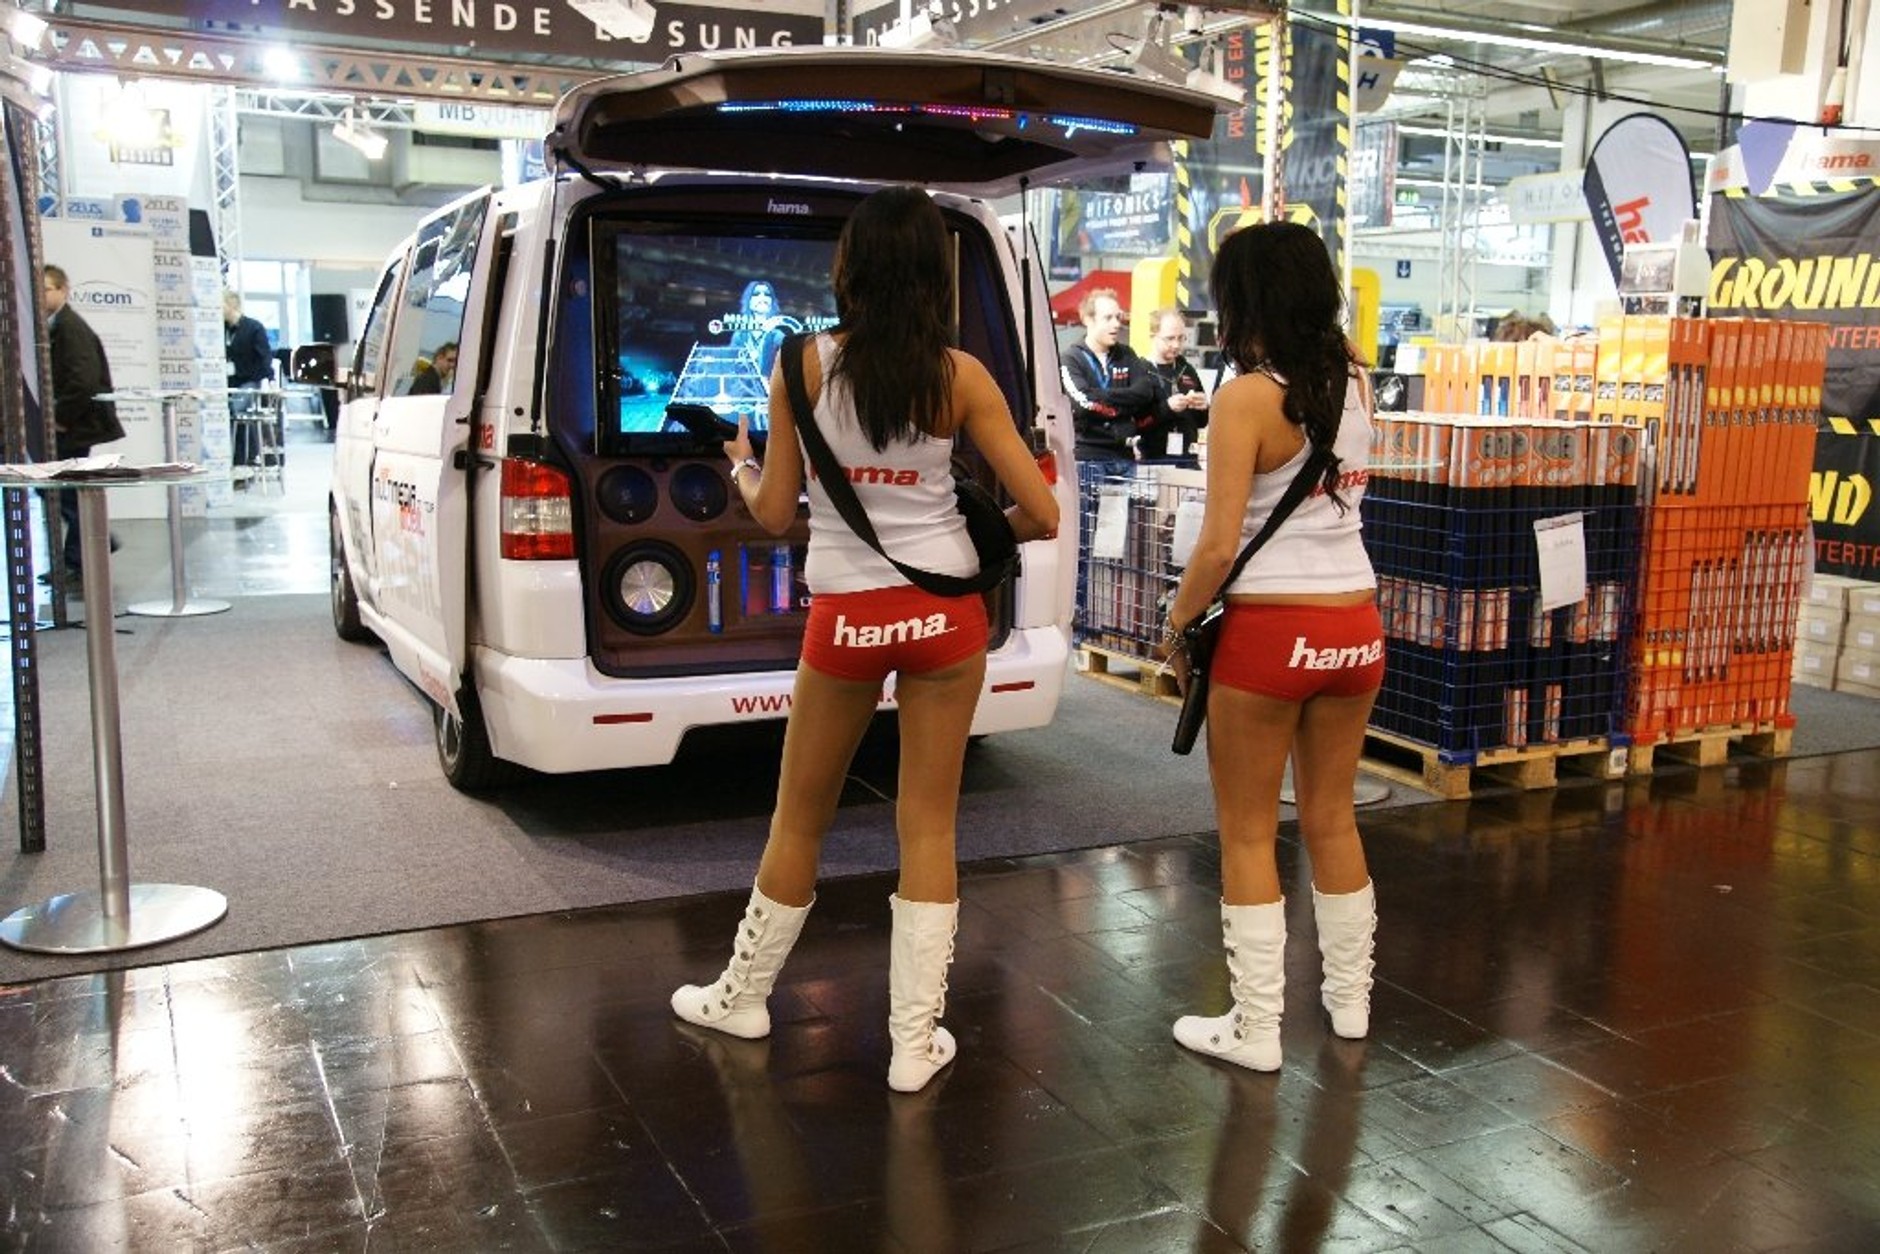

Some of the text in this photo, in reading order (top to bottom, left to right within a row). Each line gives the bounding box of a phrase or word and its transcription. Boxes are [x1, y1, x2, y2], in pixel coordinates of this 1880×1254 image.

[252, 0, 550, 35] SSENDE
[767, 198, 809, 215] hama
[1086, 189, 1160, 218] HIFONICS
[833, 612, 951, 648] hama
[1288, 636, 1382, 670] hama
